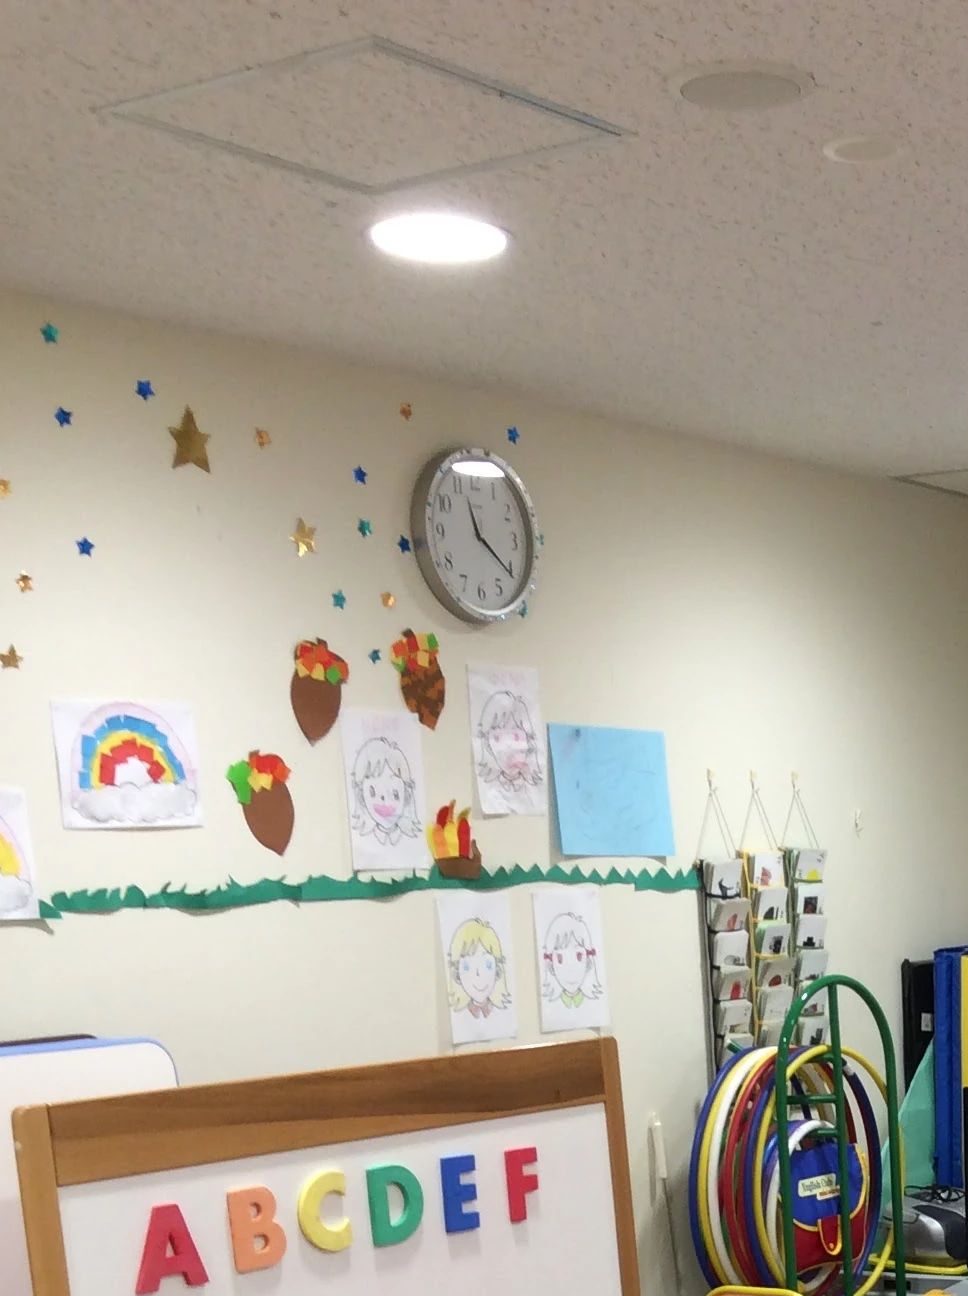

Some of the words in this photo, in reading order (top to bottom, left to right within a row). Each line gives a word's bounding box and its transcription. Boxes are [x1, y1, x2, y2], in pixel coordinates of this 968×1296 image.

[438, 494, 452, 513] 10
[435, 523, 445, 539] 9
[511, 531, 518, 551] 3
[444, 552, 454, 570] 8
[459, 574, 468, 592] 7
[477, 582, 486, 600] 6
[495, 578, 503, 596] 5
